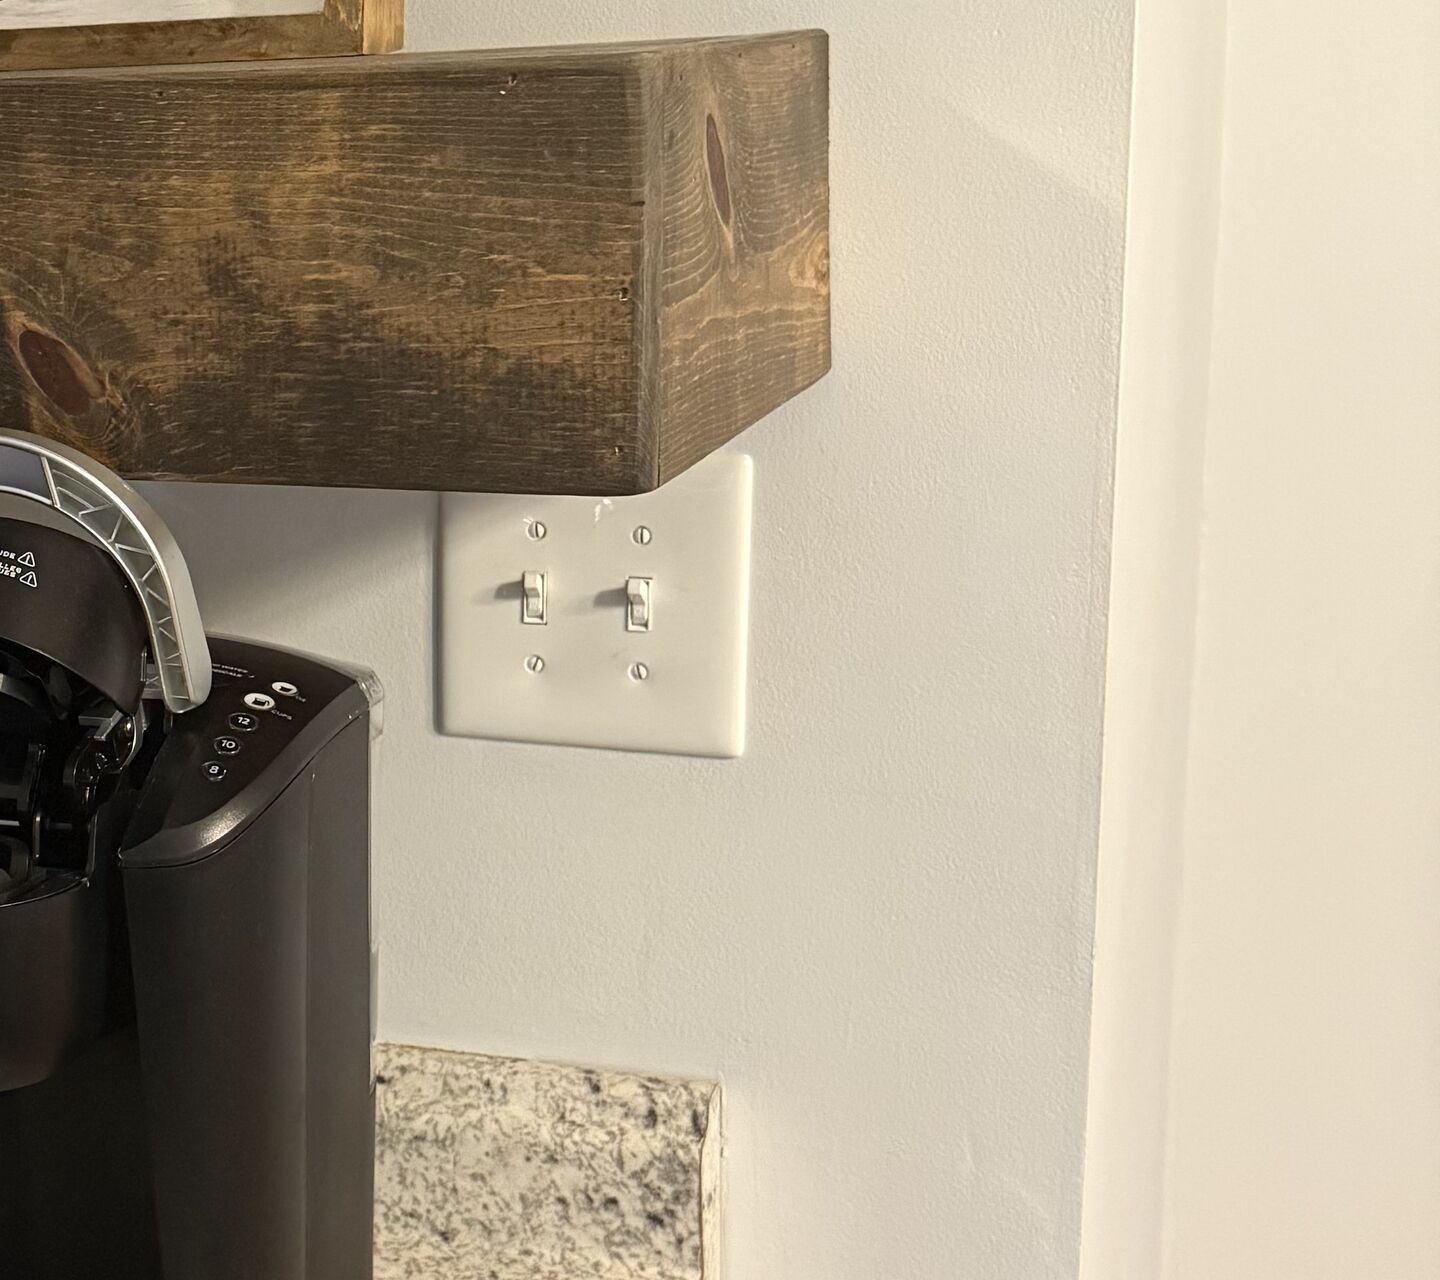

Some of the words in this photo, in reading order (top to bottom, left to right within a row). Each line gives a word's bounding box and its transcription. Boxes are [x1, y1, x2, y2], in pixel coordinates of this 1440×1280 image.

[237, 716, 250, 725] 12
[221, 739, 236, 749] 10
[209, 765, 219, 774] 8
